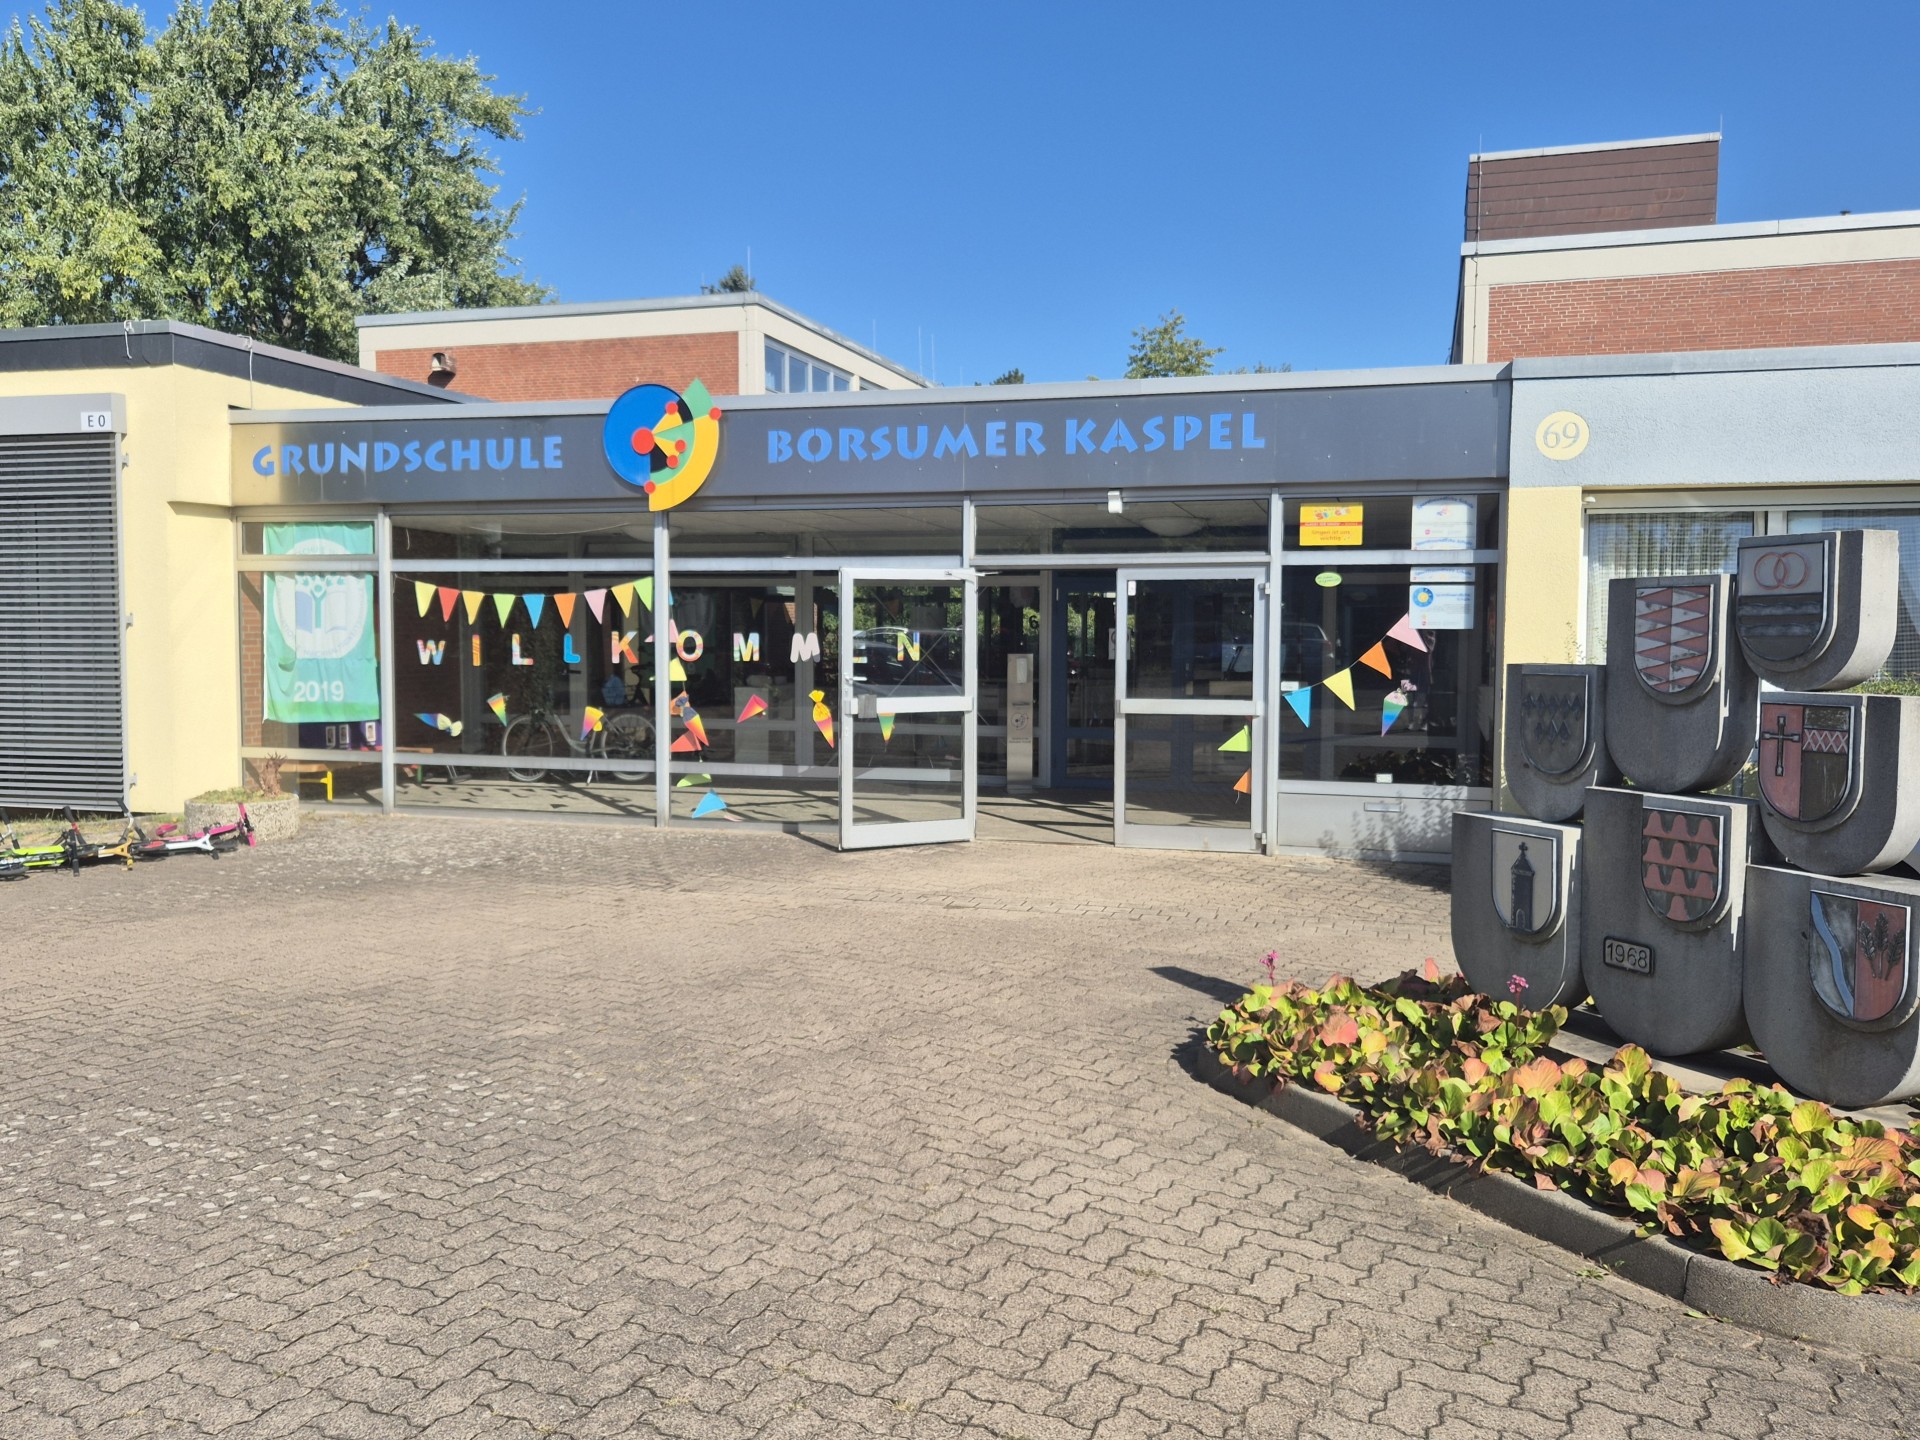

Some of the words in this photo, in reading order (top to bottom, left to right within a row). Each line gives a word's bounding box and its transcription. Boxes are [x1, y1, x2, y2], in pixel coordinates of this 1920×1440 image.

[87, 415, 94, 428] E
[1542, 420, 1581, 449] 69
[253, 435, 564, 475] GRUNDSCHULE
[767, 423, 1047, 464] BORSUMER
[1064, 411, 1267, 455] KASPEL
[293, 680, 345, 703] 2019
[1606, 942, 1648, 969] 1968
